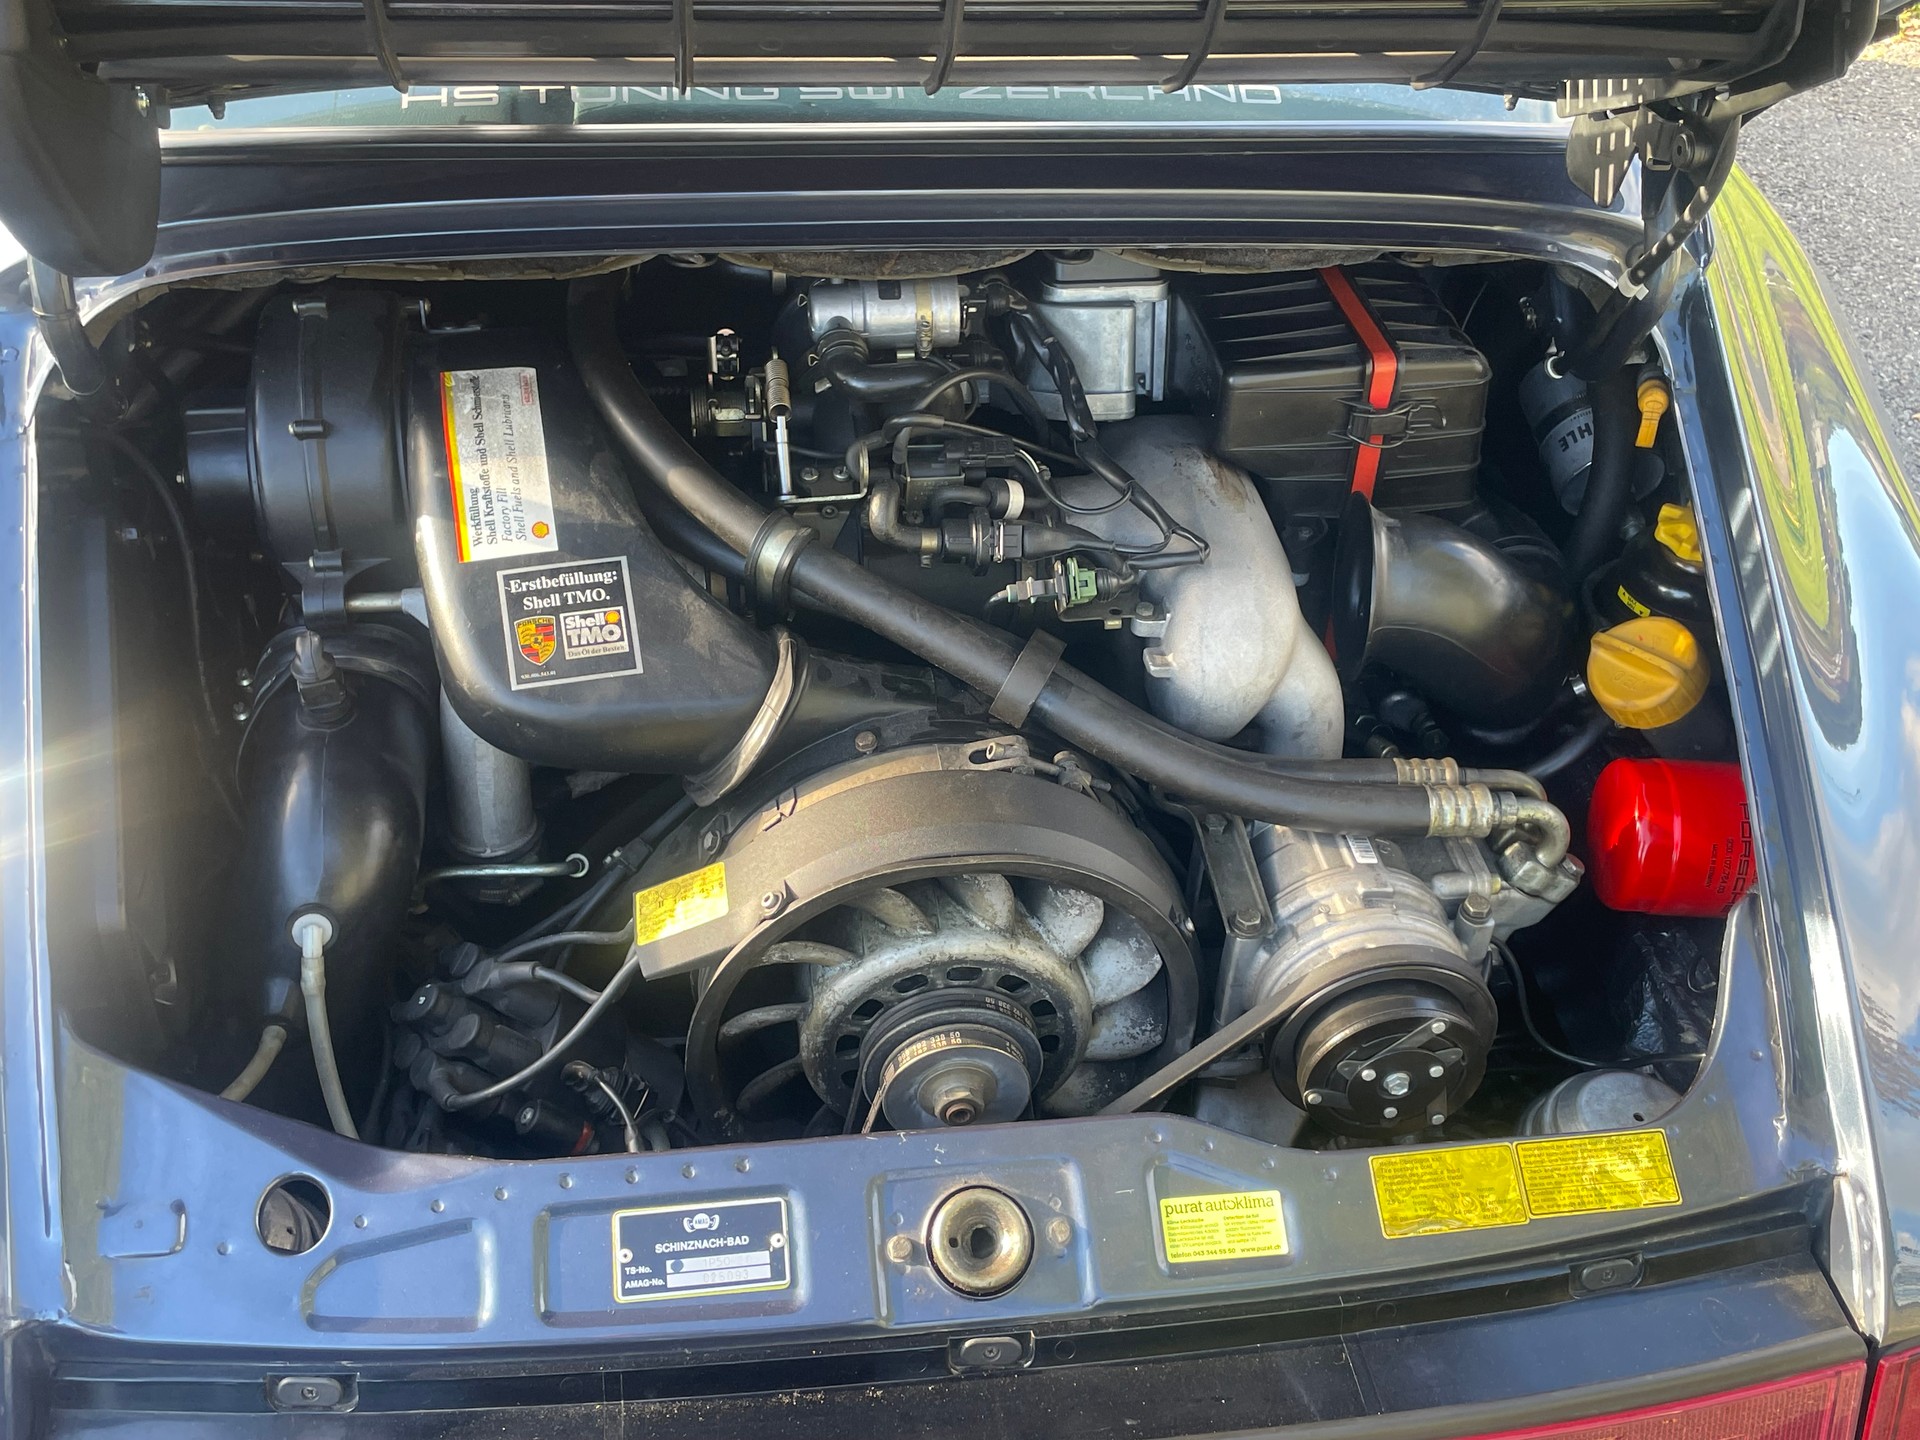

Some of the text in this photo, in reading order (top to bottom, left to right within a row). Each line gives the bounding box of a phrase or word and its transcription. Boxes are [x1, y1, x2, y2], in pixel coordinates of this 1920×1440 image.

[402, 84, 1283, 109] HS TUNING SWIZERLAND
[473, 422, 485, 446] Shell
[1558, 422, 1592, 452] HLE
[477, 447, 489, 465] und
[504, 441, 517, 465] Shell
[508, 466, 520, 485] and
[480, 468, 495, 517] Kraftstoffe
[511, 487, 523, 512] Fuels
[469, 487, 482, 547] Werkfüllung
[496, 487, 513, 542] Factory Fill
[484, 520, 498, 545] Shell
[513, 516, 527, 541] Shell
[508, 570, 618, 593] Erstbefüllung:
[523, 588, 610, 610] Shell TMO.
[565, 612, 606, 629] Shell
[566, 623, 621, 646] TMO
[567, 650, 582, 658] Das
[591, 647, 602, 655] der
[1165, 1196, 1274, 1217] purat autoklima
[655, 1235, 749, 1254] SCHINZNACH-BAD
[625, 1266, 652, 1275] TS-No.
[625, 1279, 665, 1289] AMAG-No.
